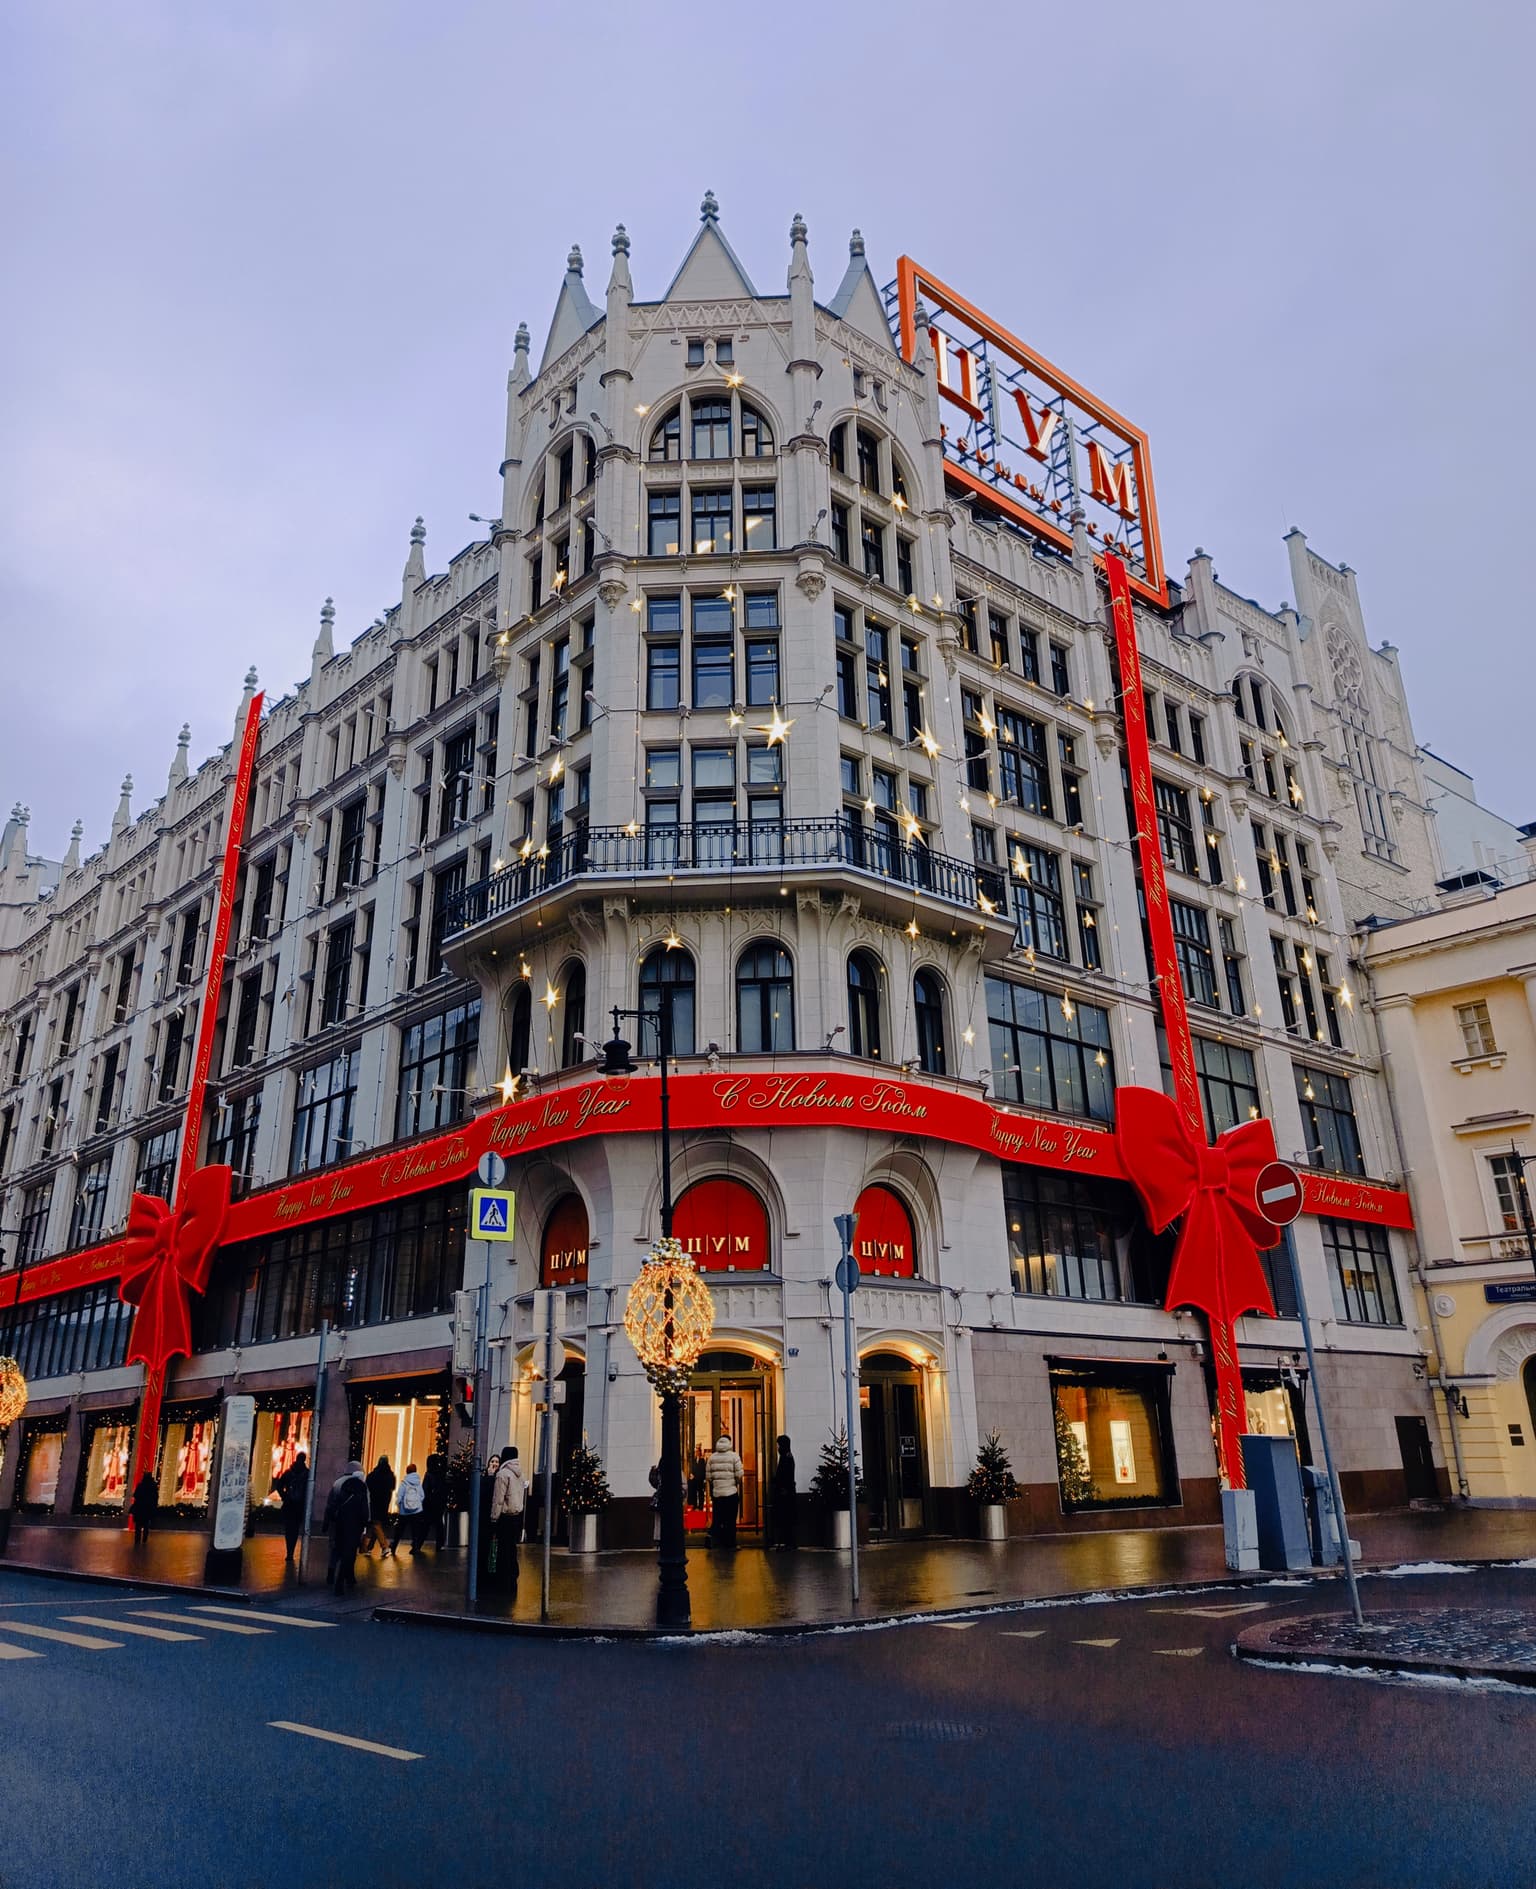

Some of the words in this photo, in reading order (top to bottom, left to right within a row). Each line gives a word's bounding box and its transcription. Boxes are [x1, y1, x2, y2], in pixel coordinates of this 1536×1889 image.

[1164, 959, 1182, 1021] Годом
[1175, 1026, 1197, 1107] Новым
[487, 1111, 530, 1149] Happy
[532, 1096, 569, 1132] New
[574, 1085, 631, 1129] Year
[713, 1077, 750, 1109] С
[748, 1075, 854, 1109] Новым
[859, 1082, 928, 1118] Годом
[989, 1113, 1025, 1154] Happy
[1025, 1125, 1057, 1152] New
[1063, 1130, 1097, 1162] Year
[392, 1151, 436, 1183] Новым
[273, 1194, 304, 1221] Happy
[328, 1176, 354, 1210] Year
[1311, 1181, 1350, 1206] Новым
[1354, 1188, 1383, 1212] Годом
[1223, 1381, 1238, 1424] New
